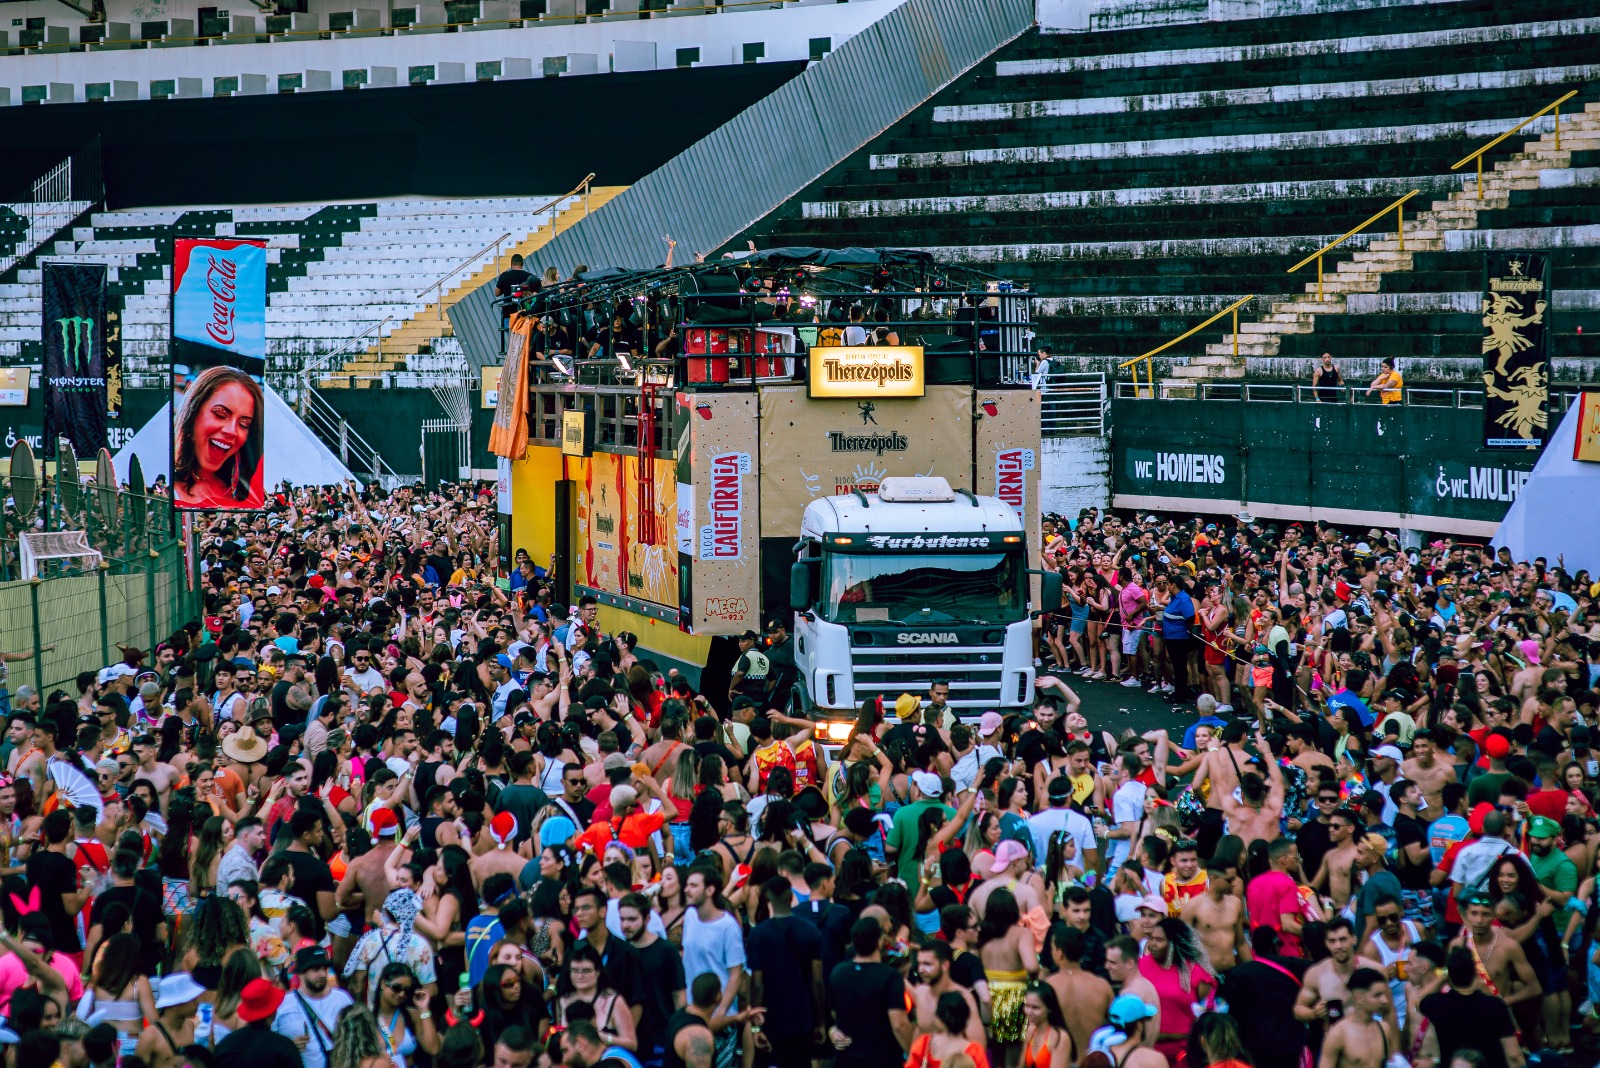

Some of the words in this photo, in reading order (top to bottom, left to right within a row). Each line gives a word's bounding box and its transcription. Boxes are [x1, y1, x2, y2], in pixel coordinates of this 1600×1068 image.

[1489, 278, 1543, 294] Therezópolis
[206, 252, 236, 345] Coca-Cola
[49, 376, 105, 387] MONSTER
[823, 358, 913, 387] Therezópolis
[25, 436, 42, 448] WC
[829, 431, 908, 456] Therezópolis
[1135, 461, 1152, 478] WC
[1156, 452, 1225, 483] HOMENS
[835, 476, 855, 485] BLOCO
[1451, 478, 1469, 498] WC
[703, 528, 713, 558] BLOCO
[866, 535, 990, 548] Turbulence
[706, 598, 748, 616] MEGA
[897, 632, 959, 644] SCANIA
